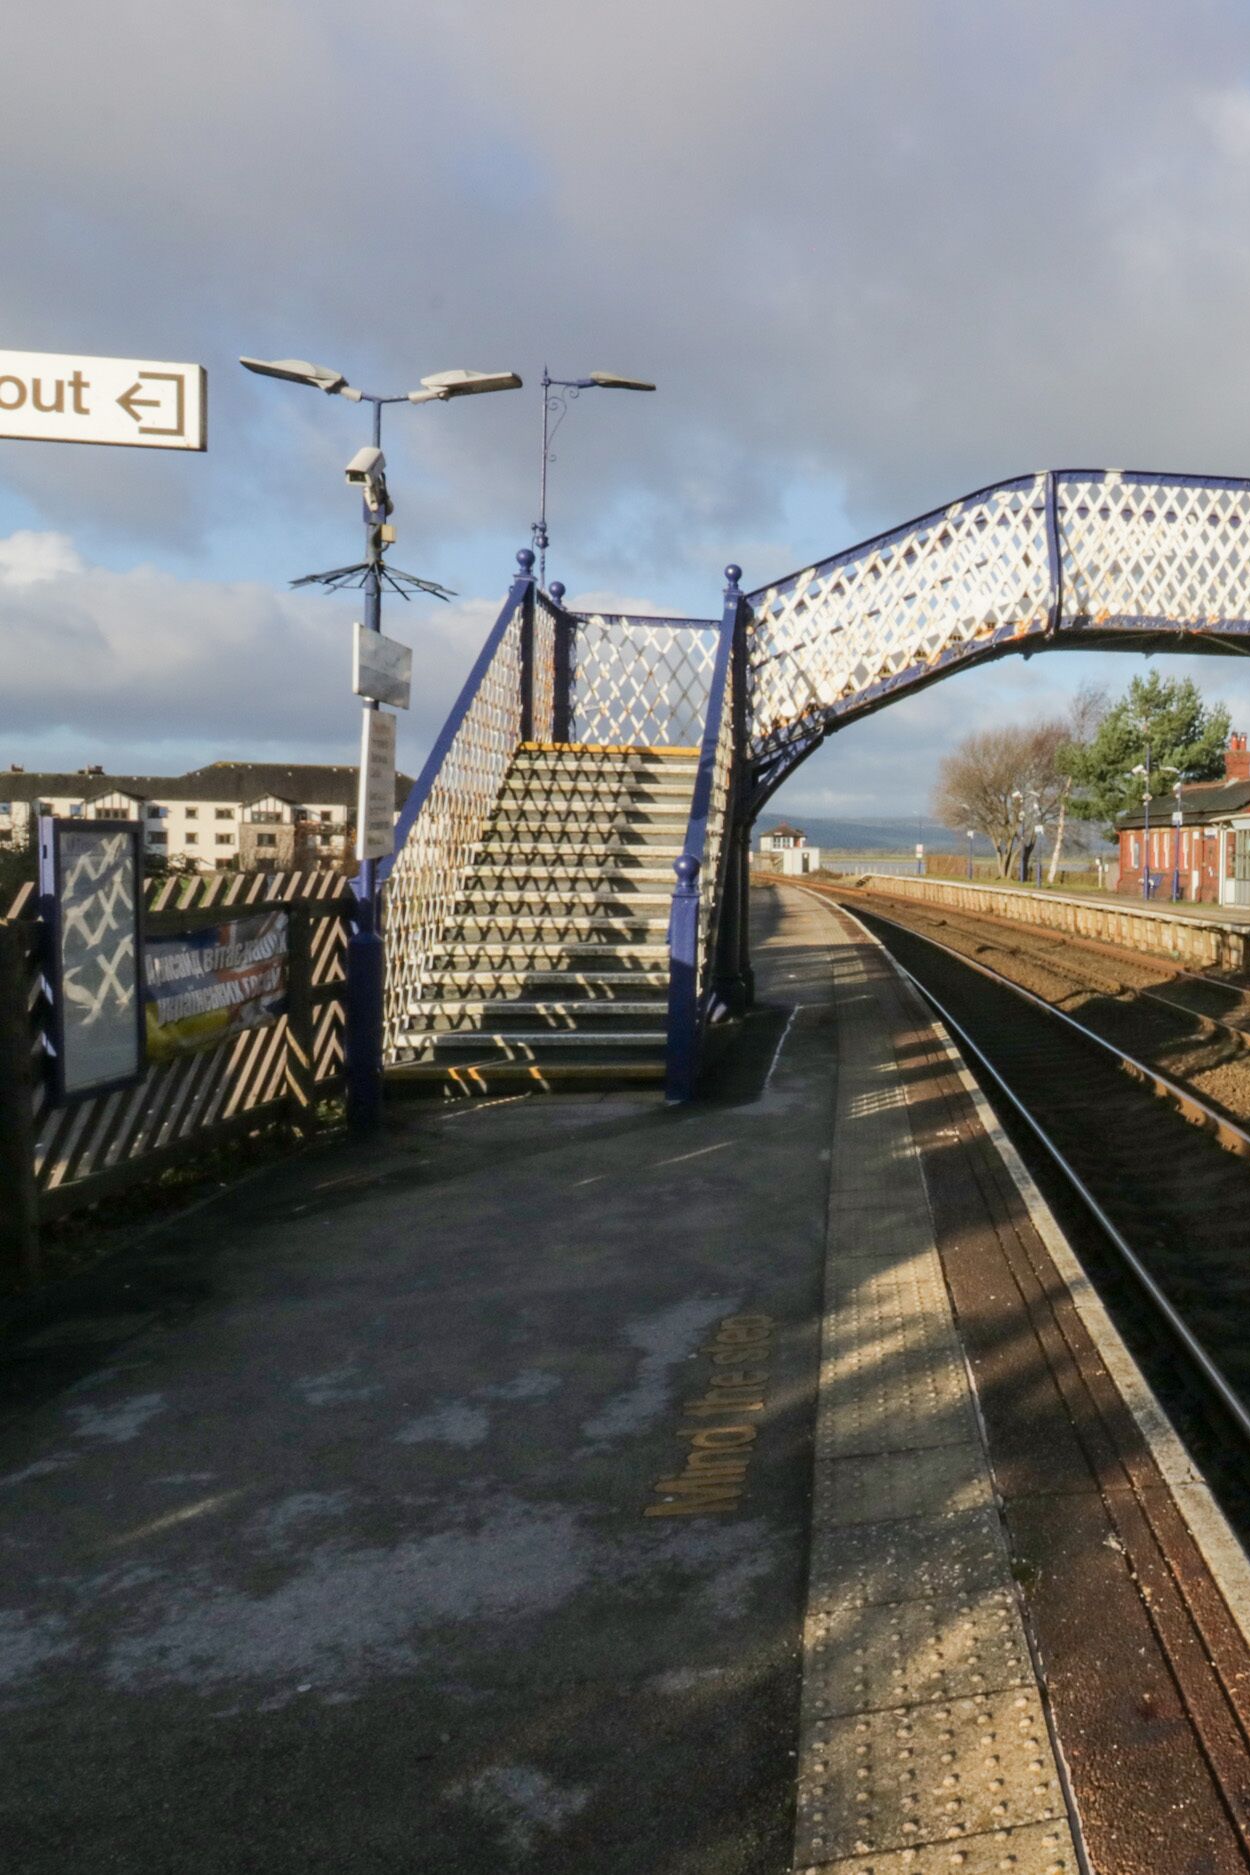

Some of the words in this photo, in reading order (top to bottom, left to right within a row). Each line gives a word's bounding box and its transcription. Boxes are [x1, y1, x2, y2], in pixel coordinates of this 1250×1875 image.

[0, 371, 90, 415] out
[701, 1315, 776, 1365] step
[683, 1371, 771, 1416] the
[643, 1424, 757, 1517] Mind
